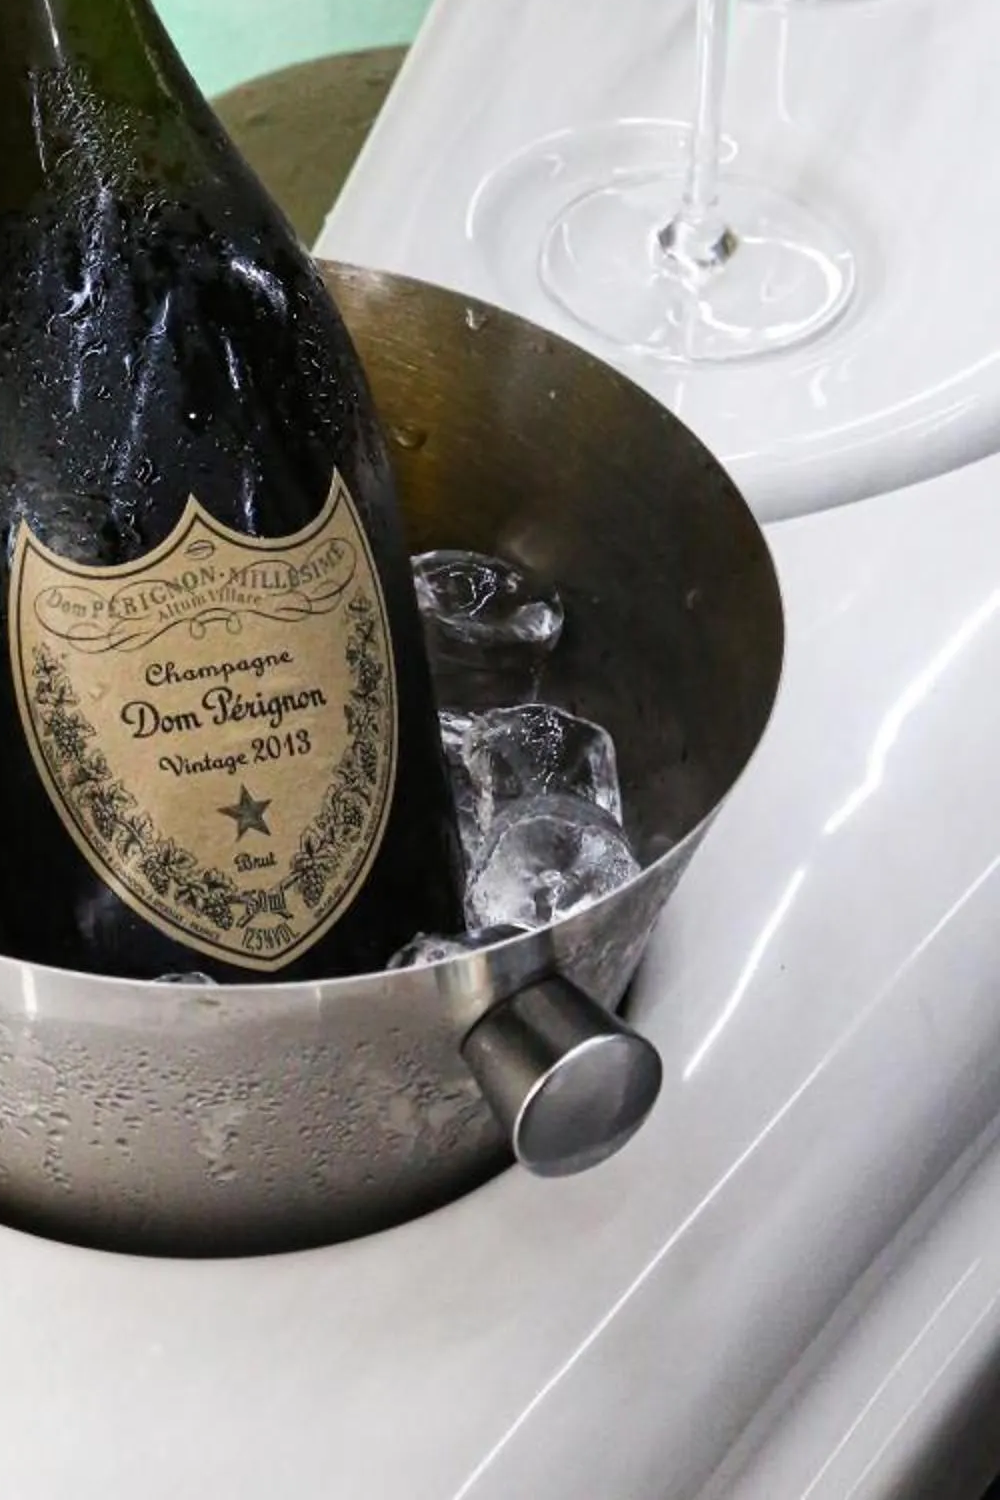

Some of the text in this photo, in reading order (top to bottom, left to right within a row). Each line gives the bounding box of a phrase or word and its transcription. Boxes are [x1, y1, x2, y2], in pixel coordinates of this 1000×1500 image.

[46, 589, 87, 618] Dom
[144, 649, 294, 687] Champagne
[120, 686, 327, 739] Dom Pérignon
[158, 728, 312, 777] Vintage 2013
[233, 851, 278, 873] Brut
